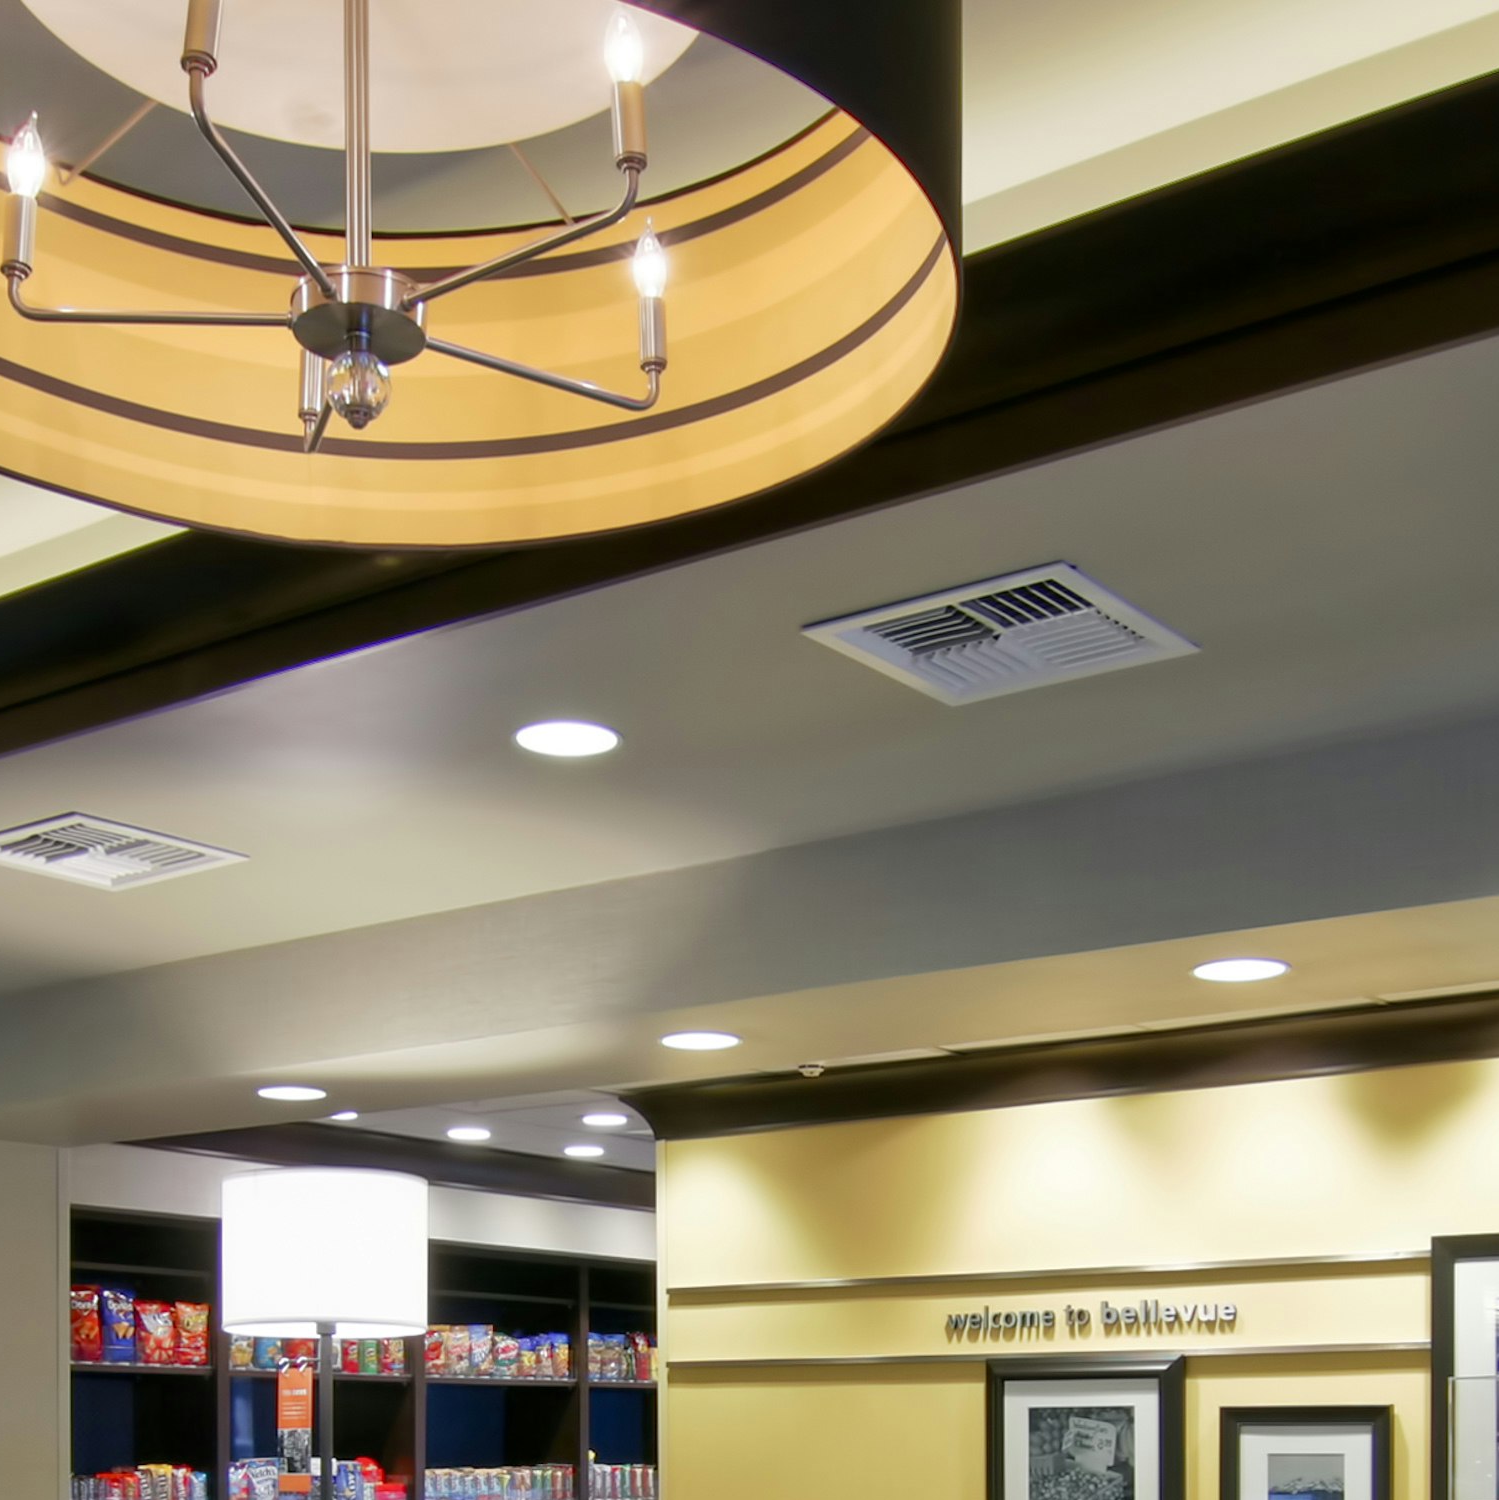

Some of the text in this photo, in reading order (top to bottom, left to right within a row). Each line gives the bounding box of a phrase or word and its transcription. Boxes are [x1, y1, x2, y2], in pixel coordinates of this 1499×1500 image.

[947, 1299, 1237, 1330] welcome to bellevue
